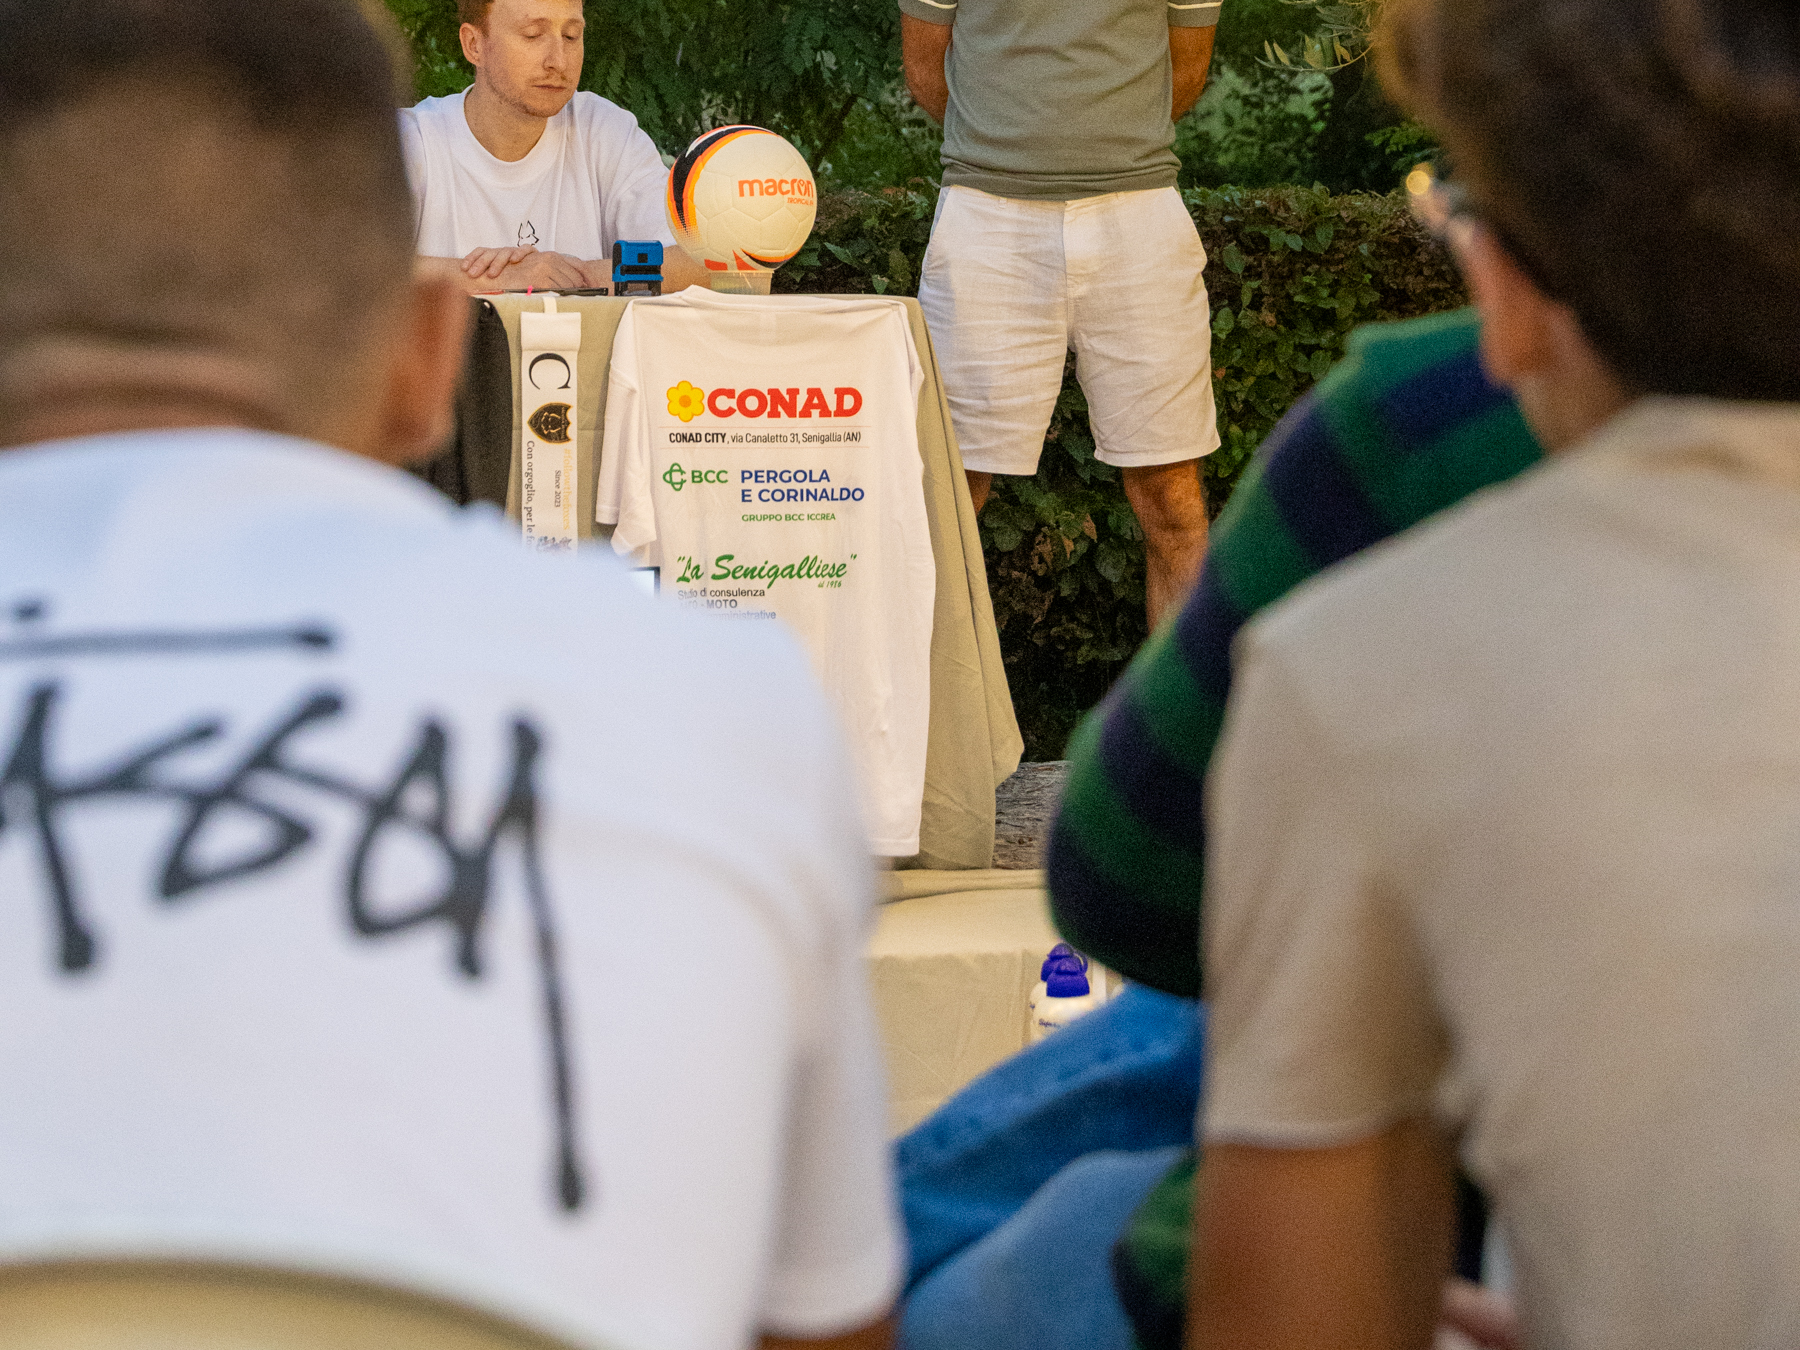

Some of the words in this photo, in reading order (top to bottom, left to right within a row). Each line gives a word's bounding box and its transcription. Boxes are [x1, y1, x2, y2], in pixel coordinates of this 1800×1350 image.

[738, 178, 814, 198] macron
[529, 353, 571, 390] C
[707, 387, 863, 419] CONAD
[669, 432, 702, 443] CONAD
[704, 432, 729, 444] CITY,
[731, 432, 743, 443] via
[745, 432, 788, 443] Canaletto
[790, 432, 800, 444] 31,
[802, 432, 842, 444] Senigallia
[843, 431, 861, 443] (AN)
[526, 440, 535, 460] Con
[524, 461, 535, 504] orgoglio,
[691, 469, 728, 483] BCC
[741, 469, 831, 483] PERGOLA
[563, 448, 573, 530] #followthefoxes
[741, 489, 752, 502] E
[758, 487, 865, 502] CORINALDO
[524, 506, 533, 522] per
[741, 513, 783, 522] GRUPPO
[784, 513, 805, 521] BCC
[807, 512, 836, 521] ICCREA
[526, 524, 535, 533] le
[709, 587, 765, 597] consulenza
[706, 599, 738, 609] MOTO
